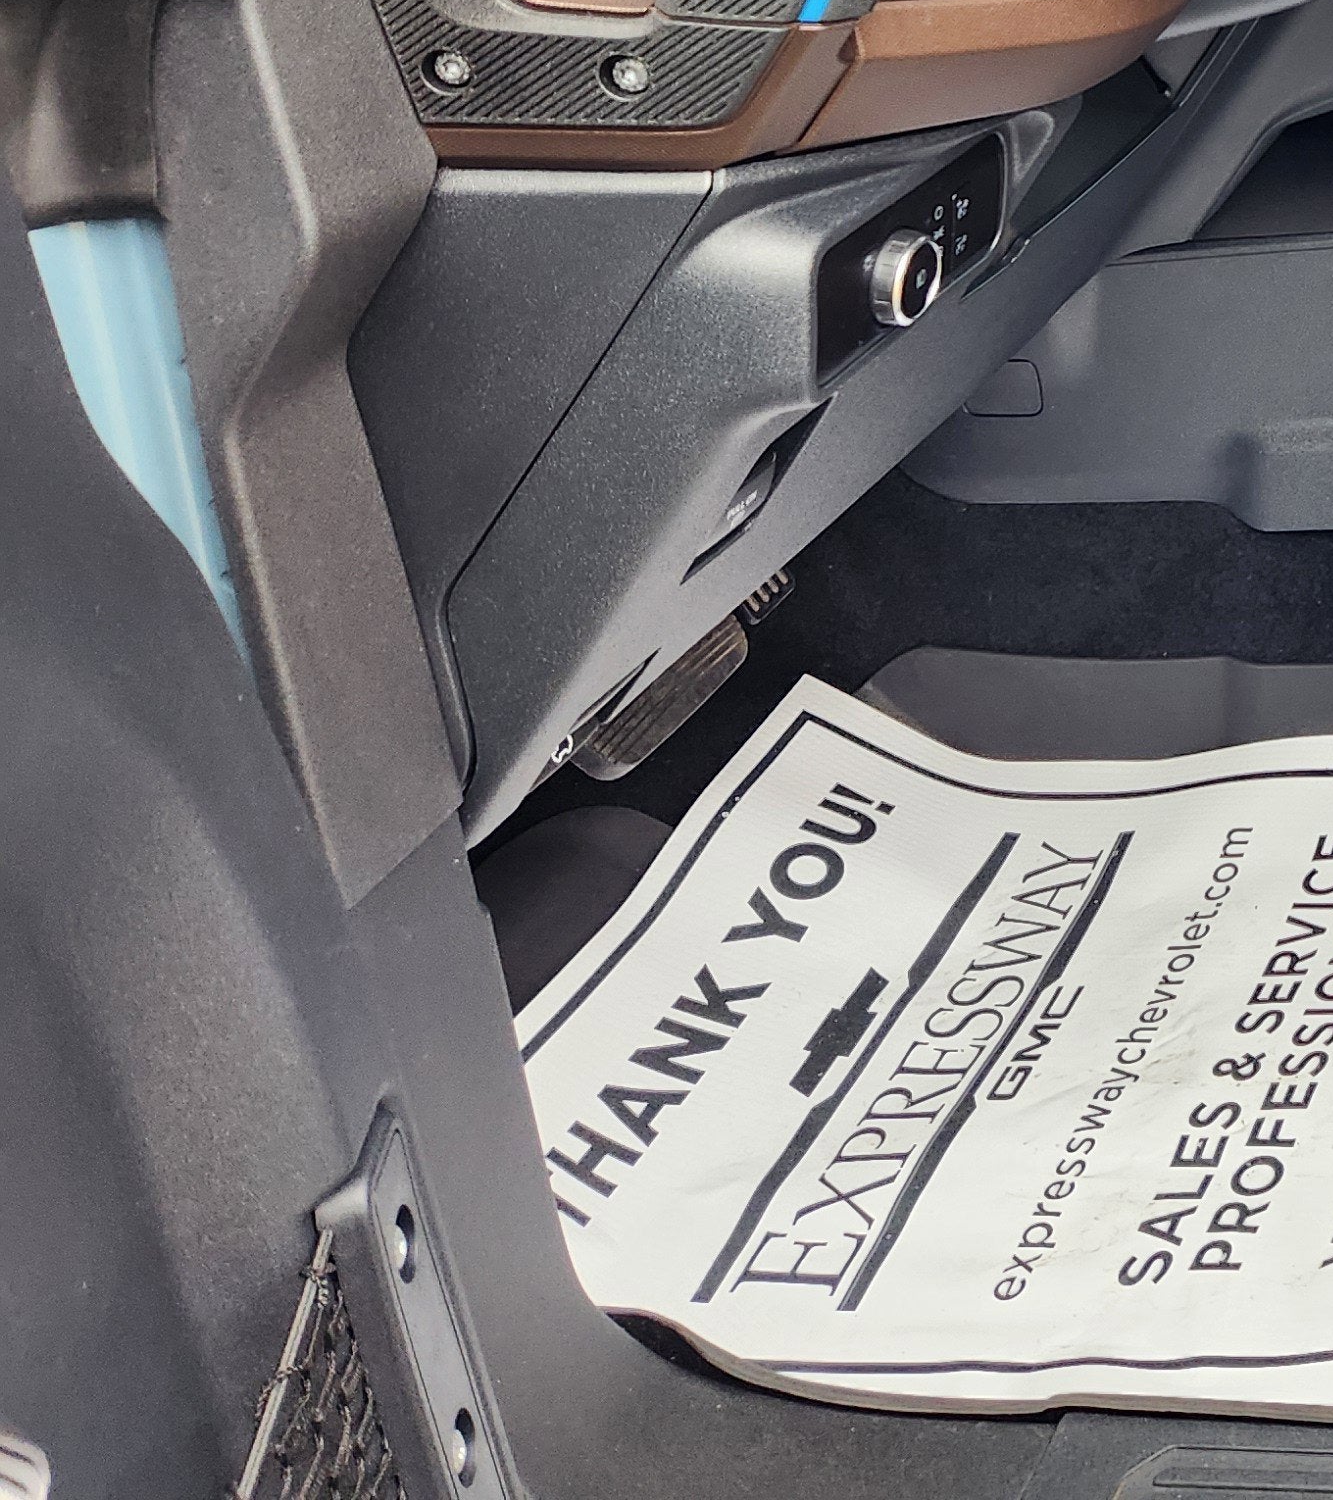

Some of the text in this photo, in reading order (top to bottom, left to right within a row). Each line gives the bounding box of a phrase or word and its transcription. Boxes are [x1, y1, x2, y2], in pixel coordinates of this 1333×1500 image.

[721, 783, 896, 943] YOU!
[729, 841, 1104, 1297] EXPRESSWAY
[986, 985, 1085, 1101] GMC
[993, 826, 1253, 1301] expresswaychevrolet.com
[1117, 1102, 1242, 1286] SALES
[1211, 1051, 1267, 1081] &
